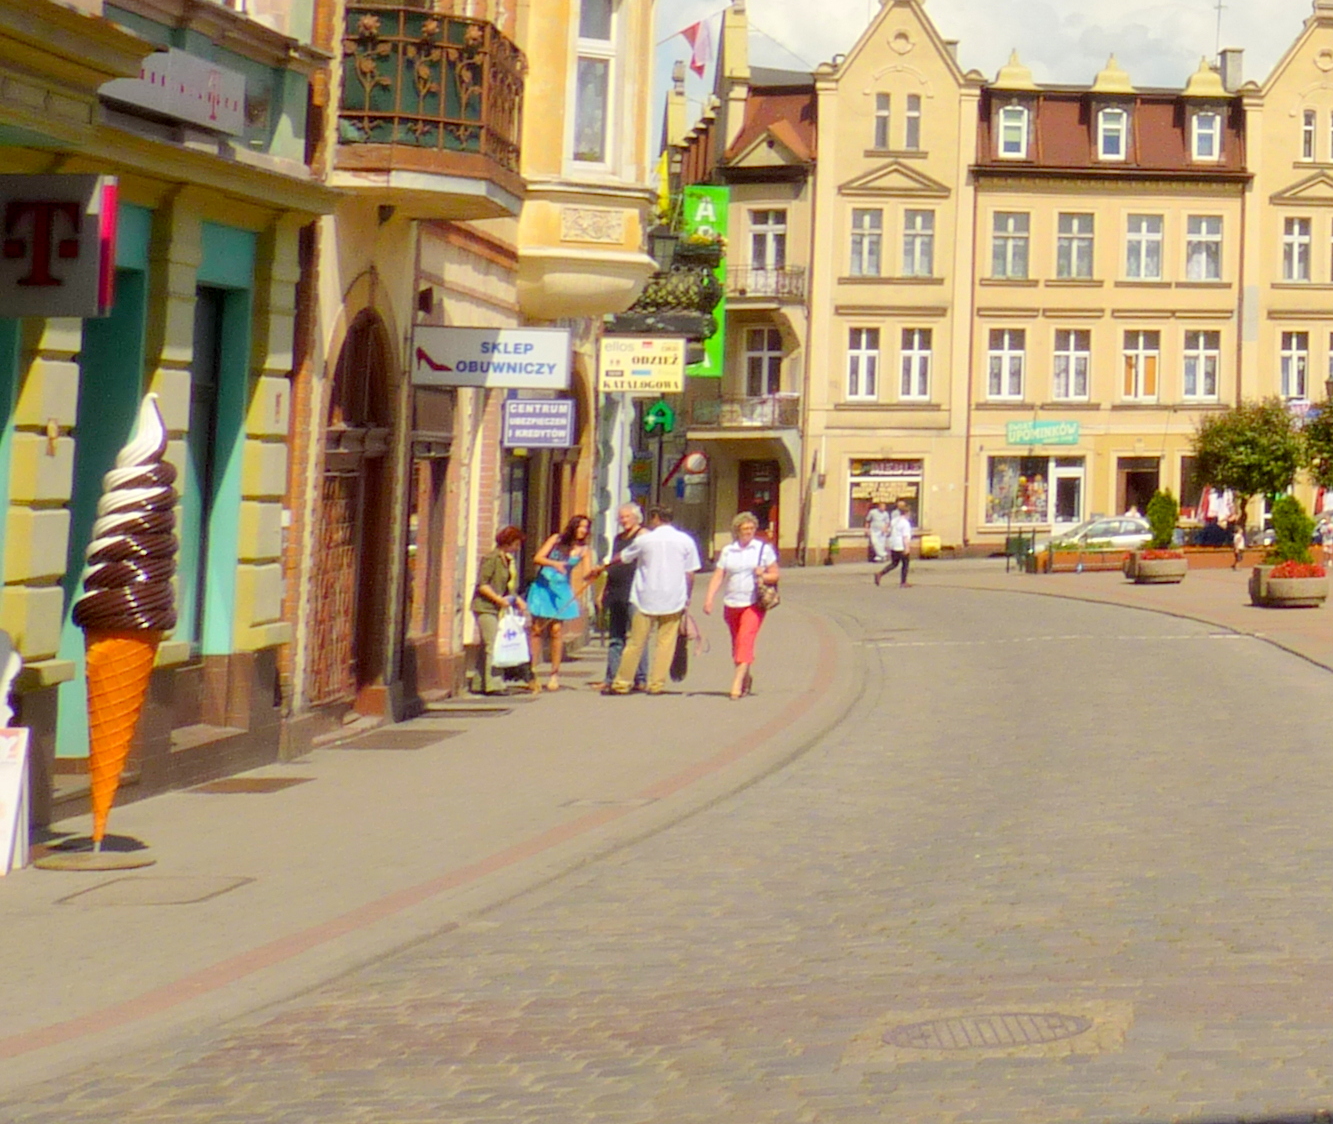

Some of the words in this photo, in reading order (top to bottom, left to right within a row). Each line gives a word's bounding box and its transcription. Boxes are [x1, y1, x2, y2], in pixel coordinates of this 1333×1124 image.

[480, 342, 534, 356] SKLEP
[632, 353, 679, 365] ODZIEŻ
[455, 359, 557, 375] OBUWNICZY
[603, 380, 680, 389] KATALOGOWA
[510, 404, 568, 414] CENTRUM
[1007, 422, 1078, 443] UPOMINKÓW
